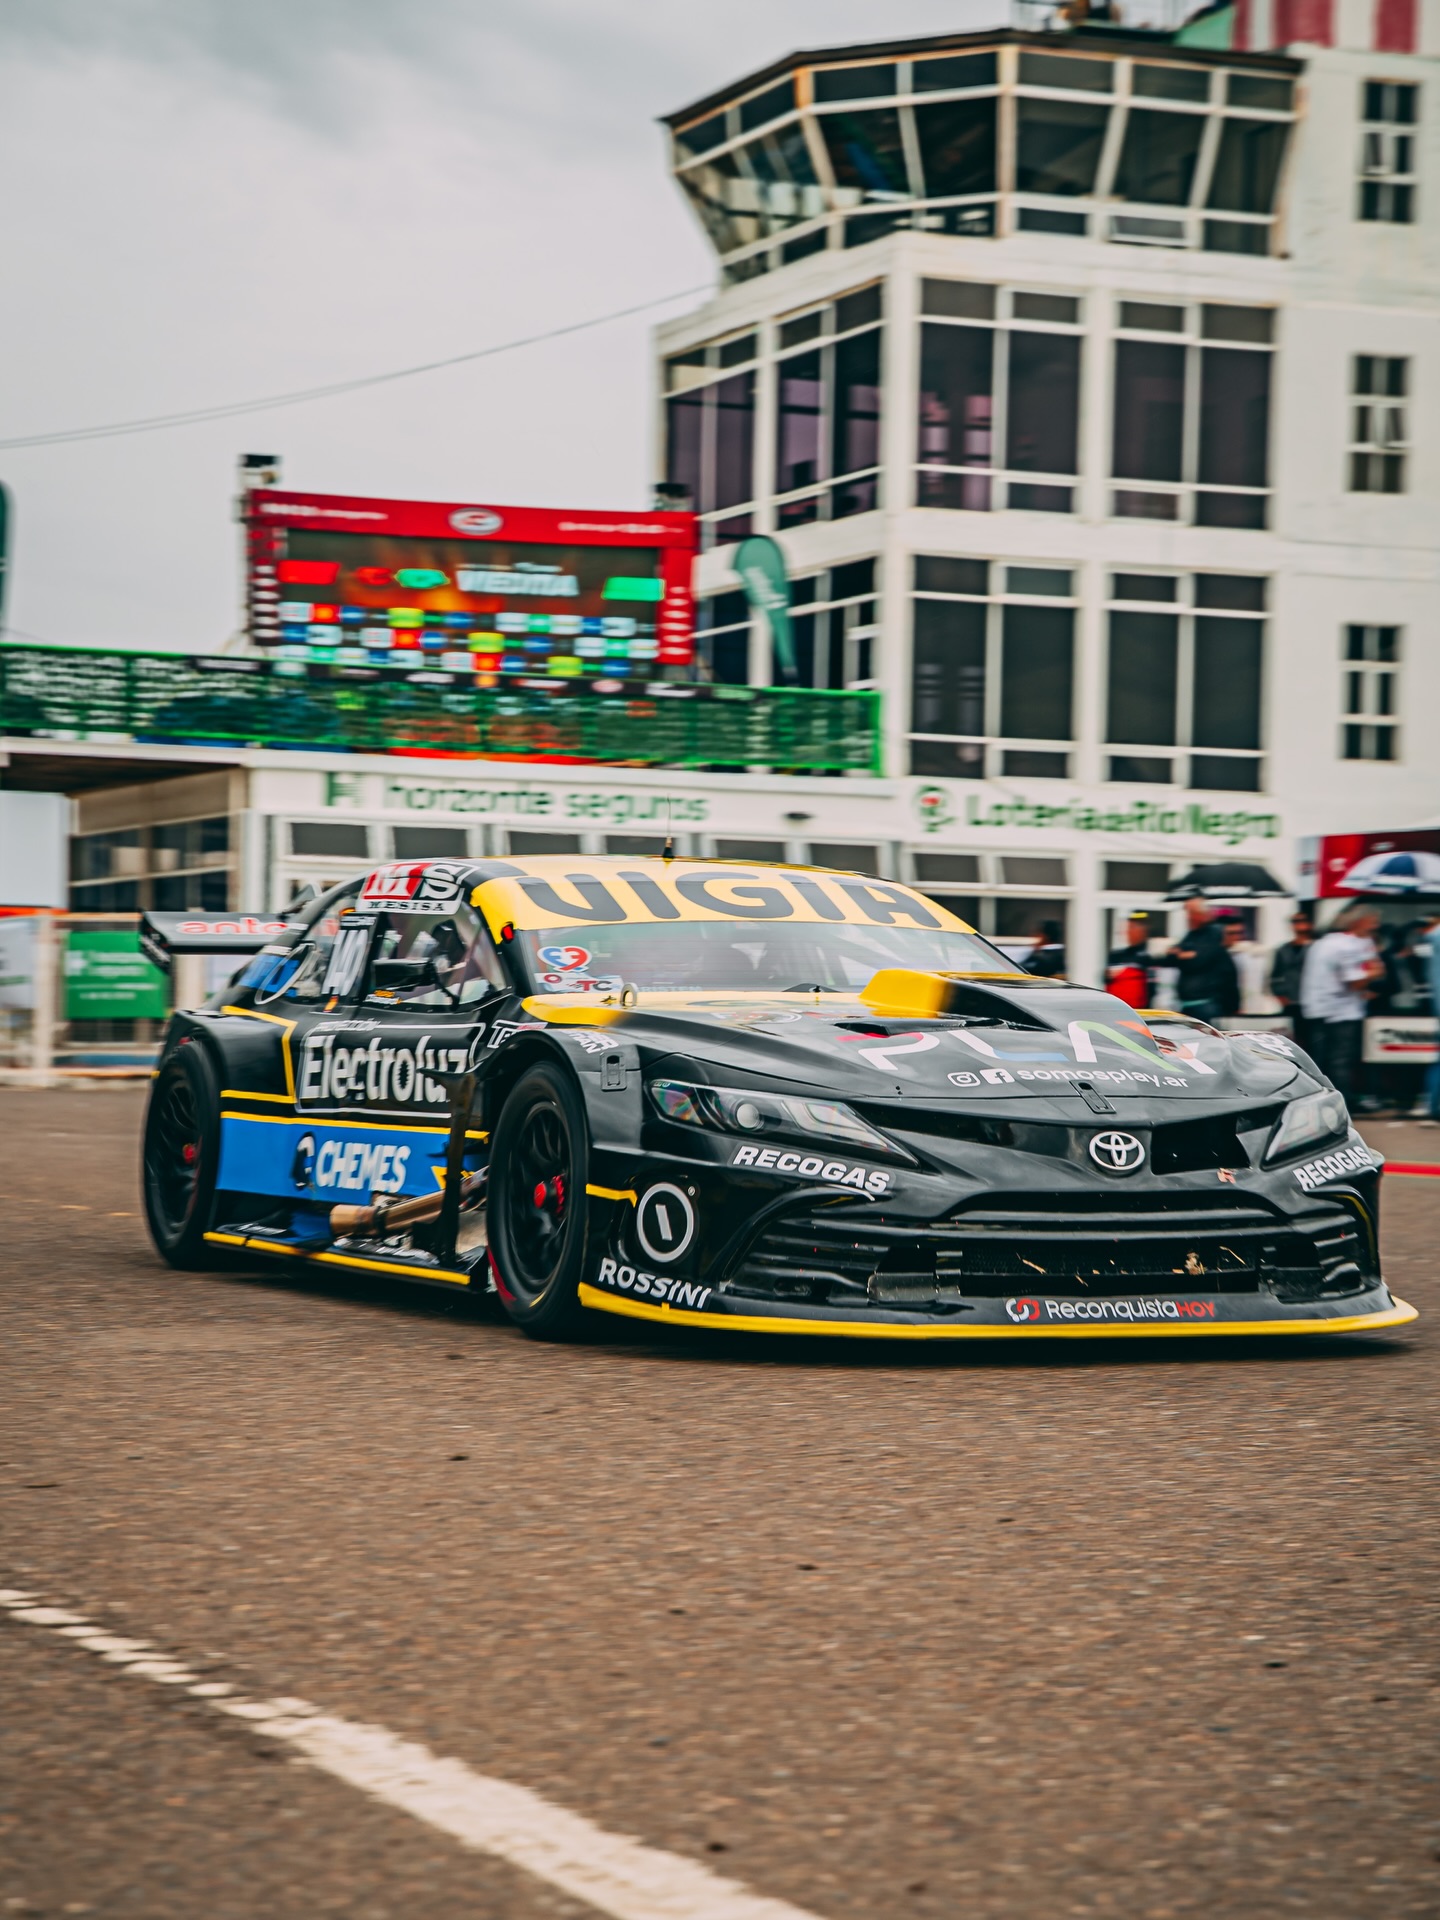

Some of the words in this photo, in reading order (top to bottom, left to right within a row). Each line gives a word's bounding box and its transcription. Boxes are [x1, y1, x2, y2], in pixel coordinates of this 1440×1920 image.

[368, 901, 445, 912] MESISA
[1017, 1068, 1189, 1089] somosplay.ar
[316, 1140, 412, 1193] CHEMES
[732, 1145, 890, 1193] RECOGAS
[1292, 1145, 1373, 1192] RECOGAS
[598, 1257, 712, 1309] ROSSINI
[1045, 1297, 1215, 1321] ReconquistaHOY
